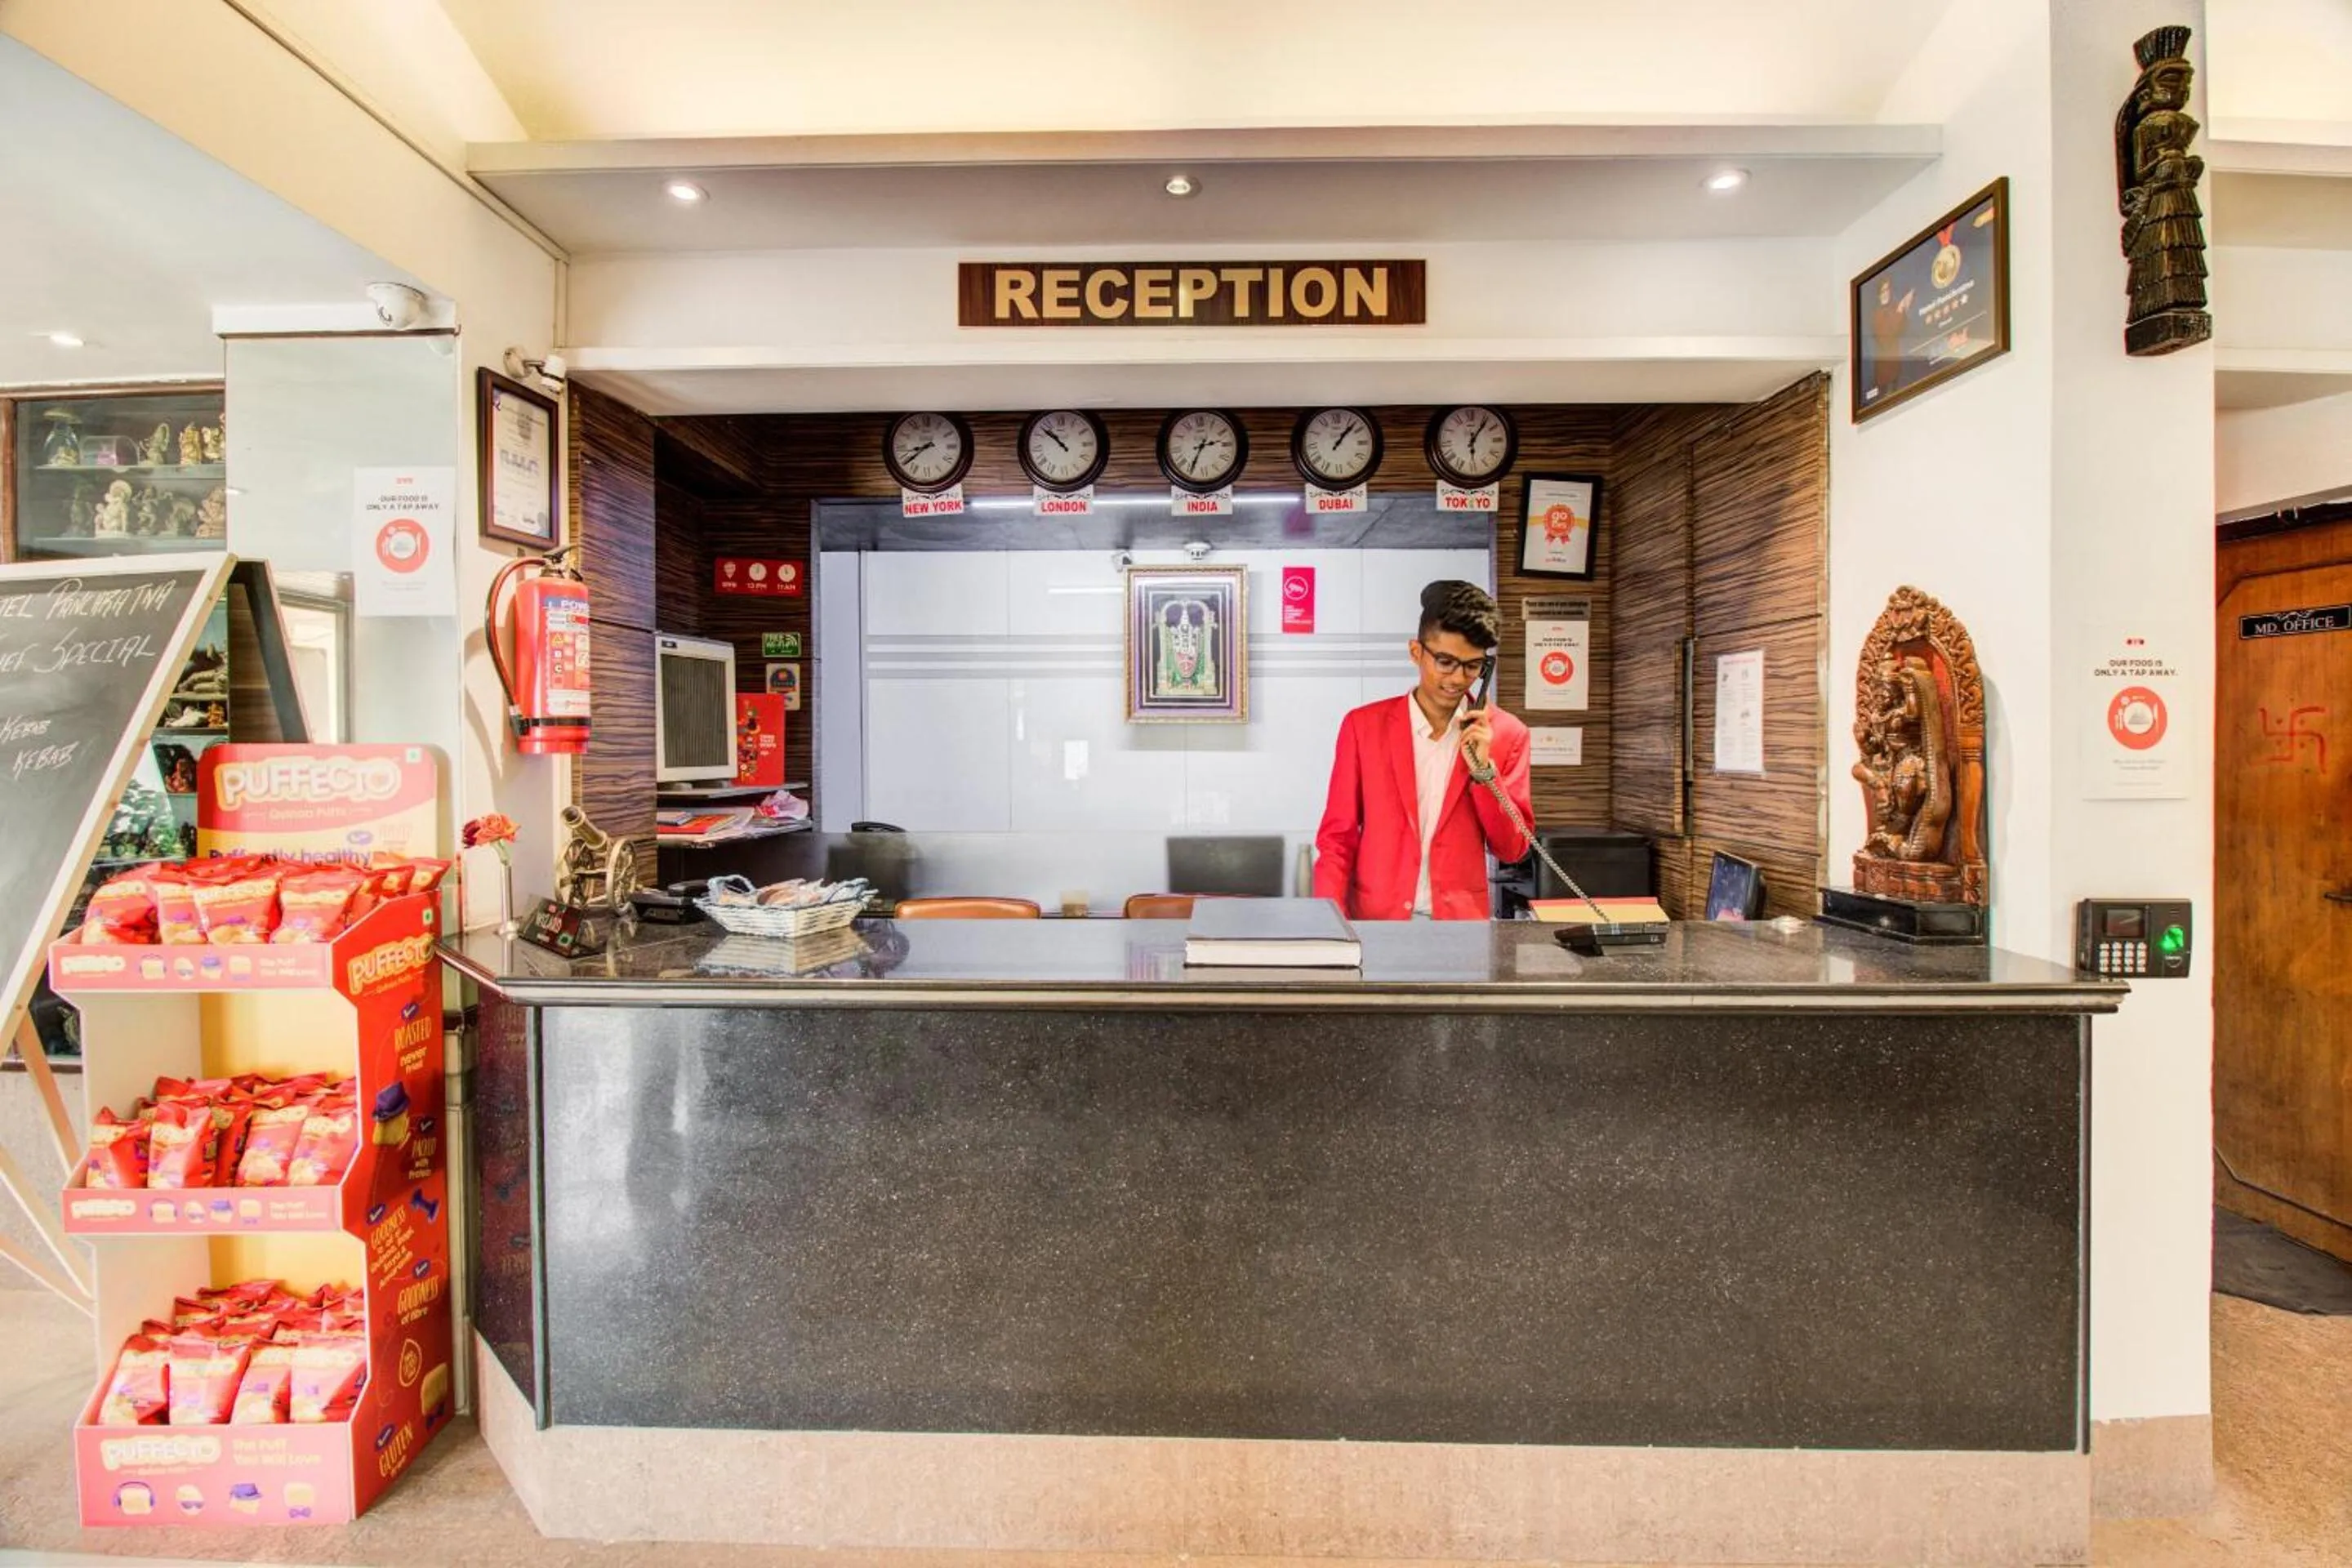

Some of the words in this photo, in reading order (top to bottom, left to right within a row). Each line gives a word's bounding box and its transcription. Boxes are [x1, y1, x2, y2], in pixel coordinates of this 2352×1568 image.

[994, 267, 1388, 319] RECEPTION
[905, 501, 929, 514] NEW
[932, 500, 963, 512] YORK
[1040, 501, 1087, 513] LONDON
[1187, 501, 1218, 512] INDIA
[1318, 497, 1353, 510] DUBAI
[2283, 616, 2335, 631] OFFICE
[33, 627, 156, 674] SPECIAL
[2109, 659, 2127, 667] OUR
[2129, 659, 2154, 667] FOOD
[2154, 659, 2163, 667] IS
[2094, 669, 2118, 677] ONLY
[2120, 669, 2127, 677] A
[2129, 669, 2147, 677] TAP
[13, 741, 79, 780] KEBAB
[219, 759, 400, 808] PUFFECTO
[349, 934, 435, 995] PUFFECTO
[103, 1437, 220, 1470] PUFFECTO
